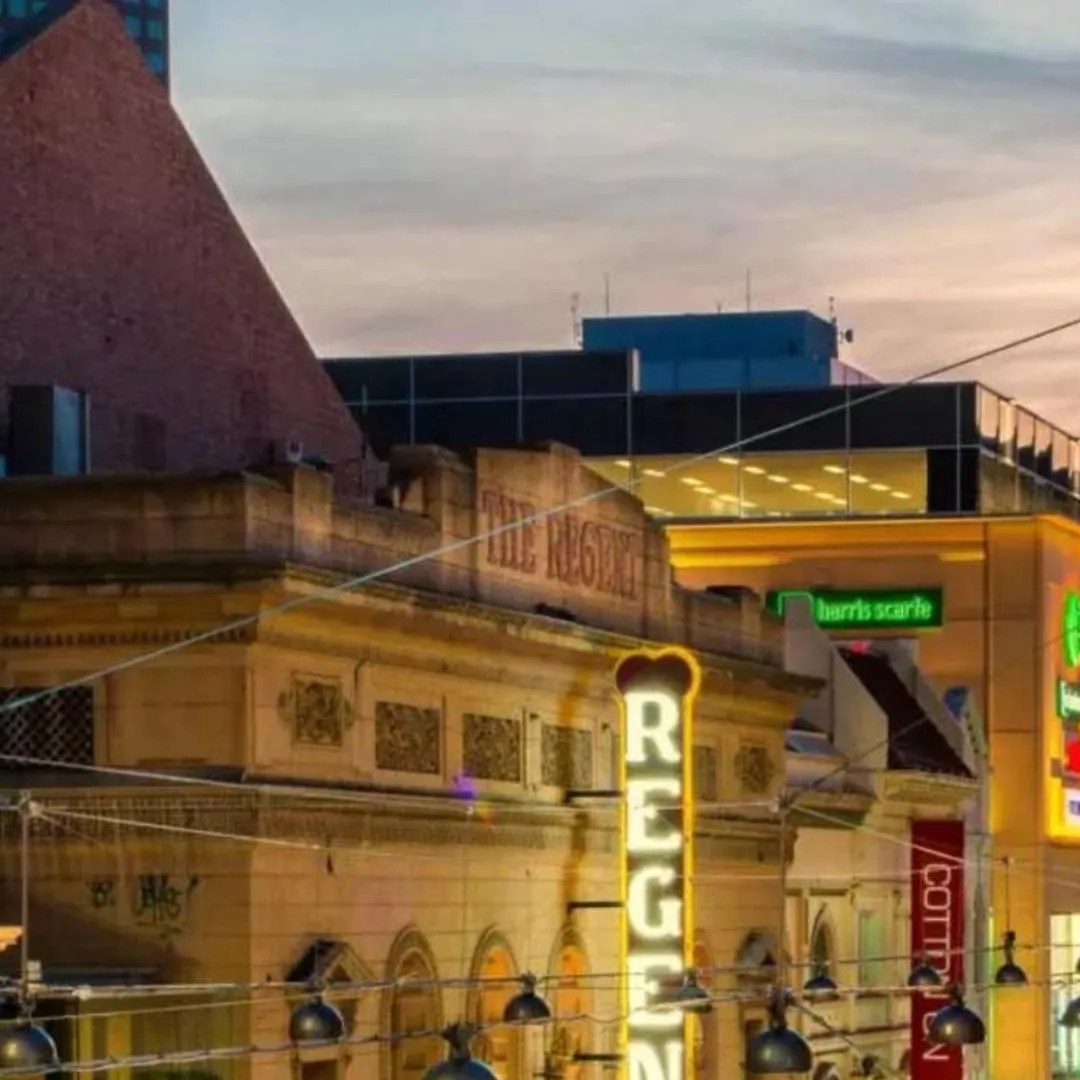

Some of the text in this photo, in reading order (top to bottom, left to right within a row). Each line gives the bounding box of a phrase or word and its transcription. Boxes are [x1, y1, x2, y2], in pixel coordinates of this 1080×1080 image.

[482, 490, 638, 600] THE REGENT
[817, 594, 933, 621] harris scarfe
